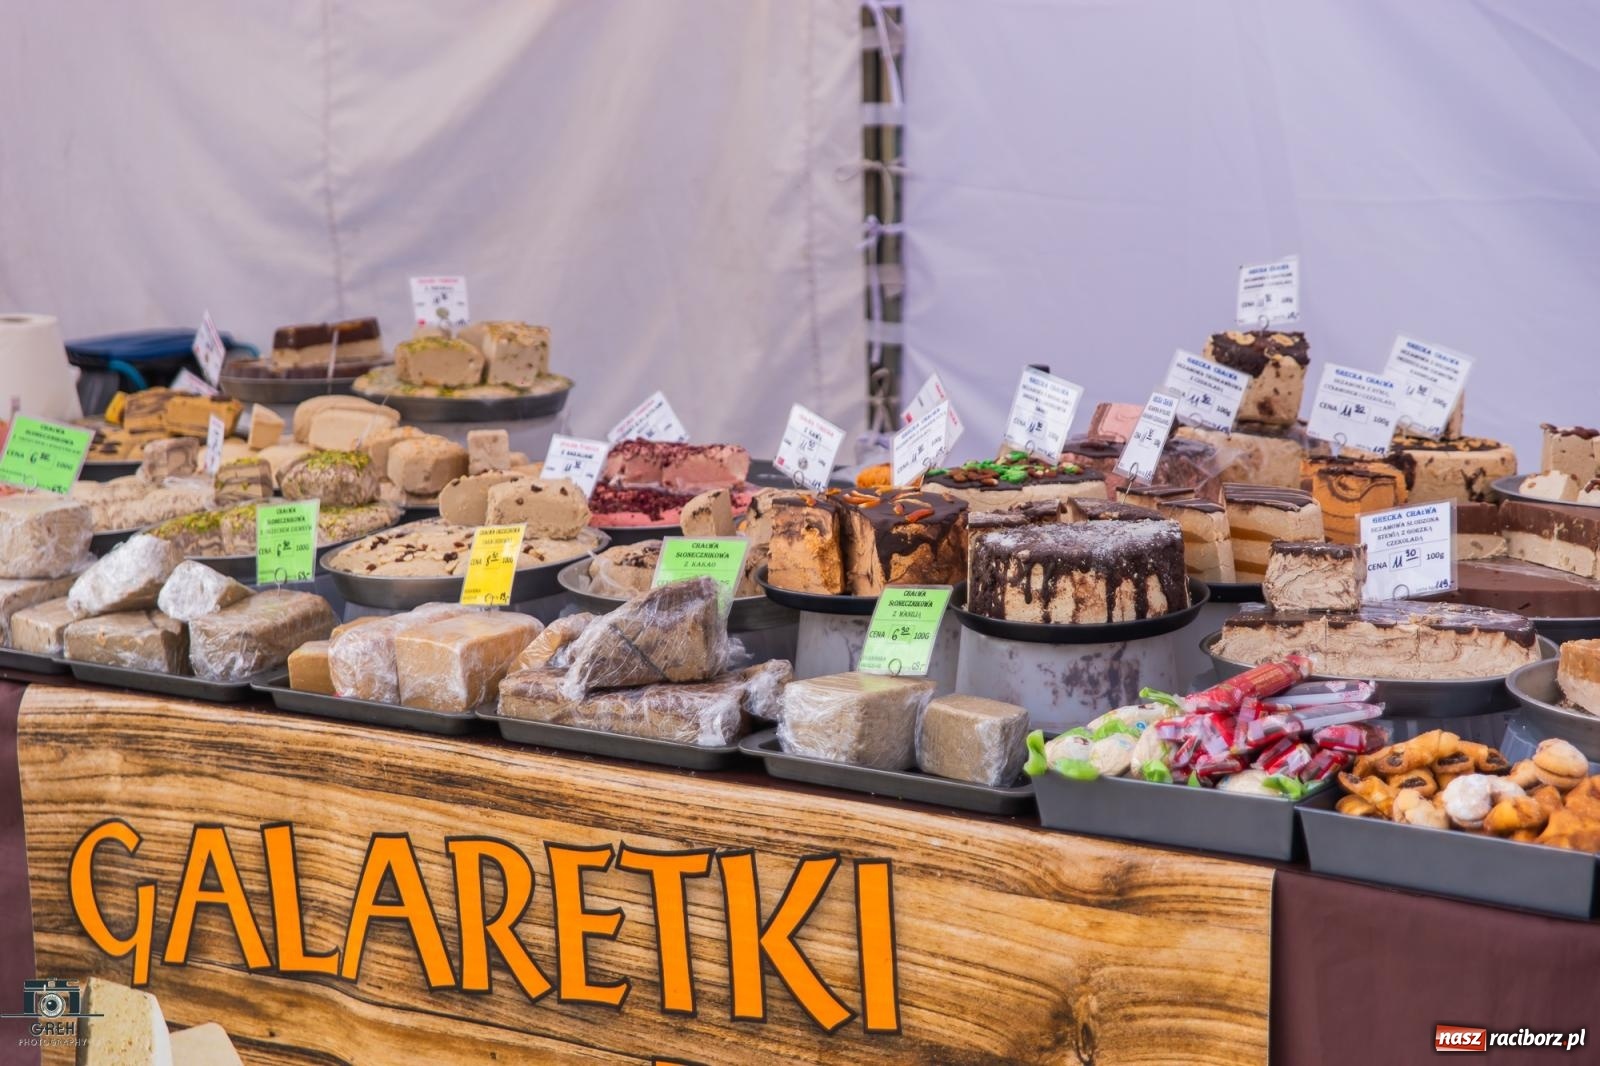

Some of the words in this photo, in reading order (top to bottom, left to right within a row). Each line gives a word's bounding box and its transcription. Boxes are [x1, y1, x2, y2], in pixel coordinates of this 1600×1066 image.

[691, 560, 717, 568] KAKAO
[1367, 561, 1388, 572] CENA
[1426, 551, 1446, 561] 100g
[868, 630, 887, 639] CENA
[913, 631, 931, 640] 100G
[69, 816, 902, 1035] GALARETKI
